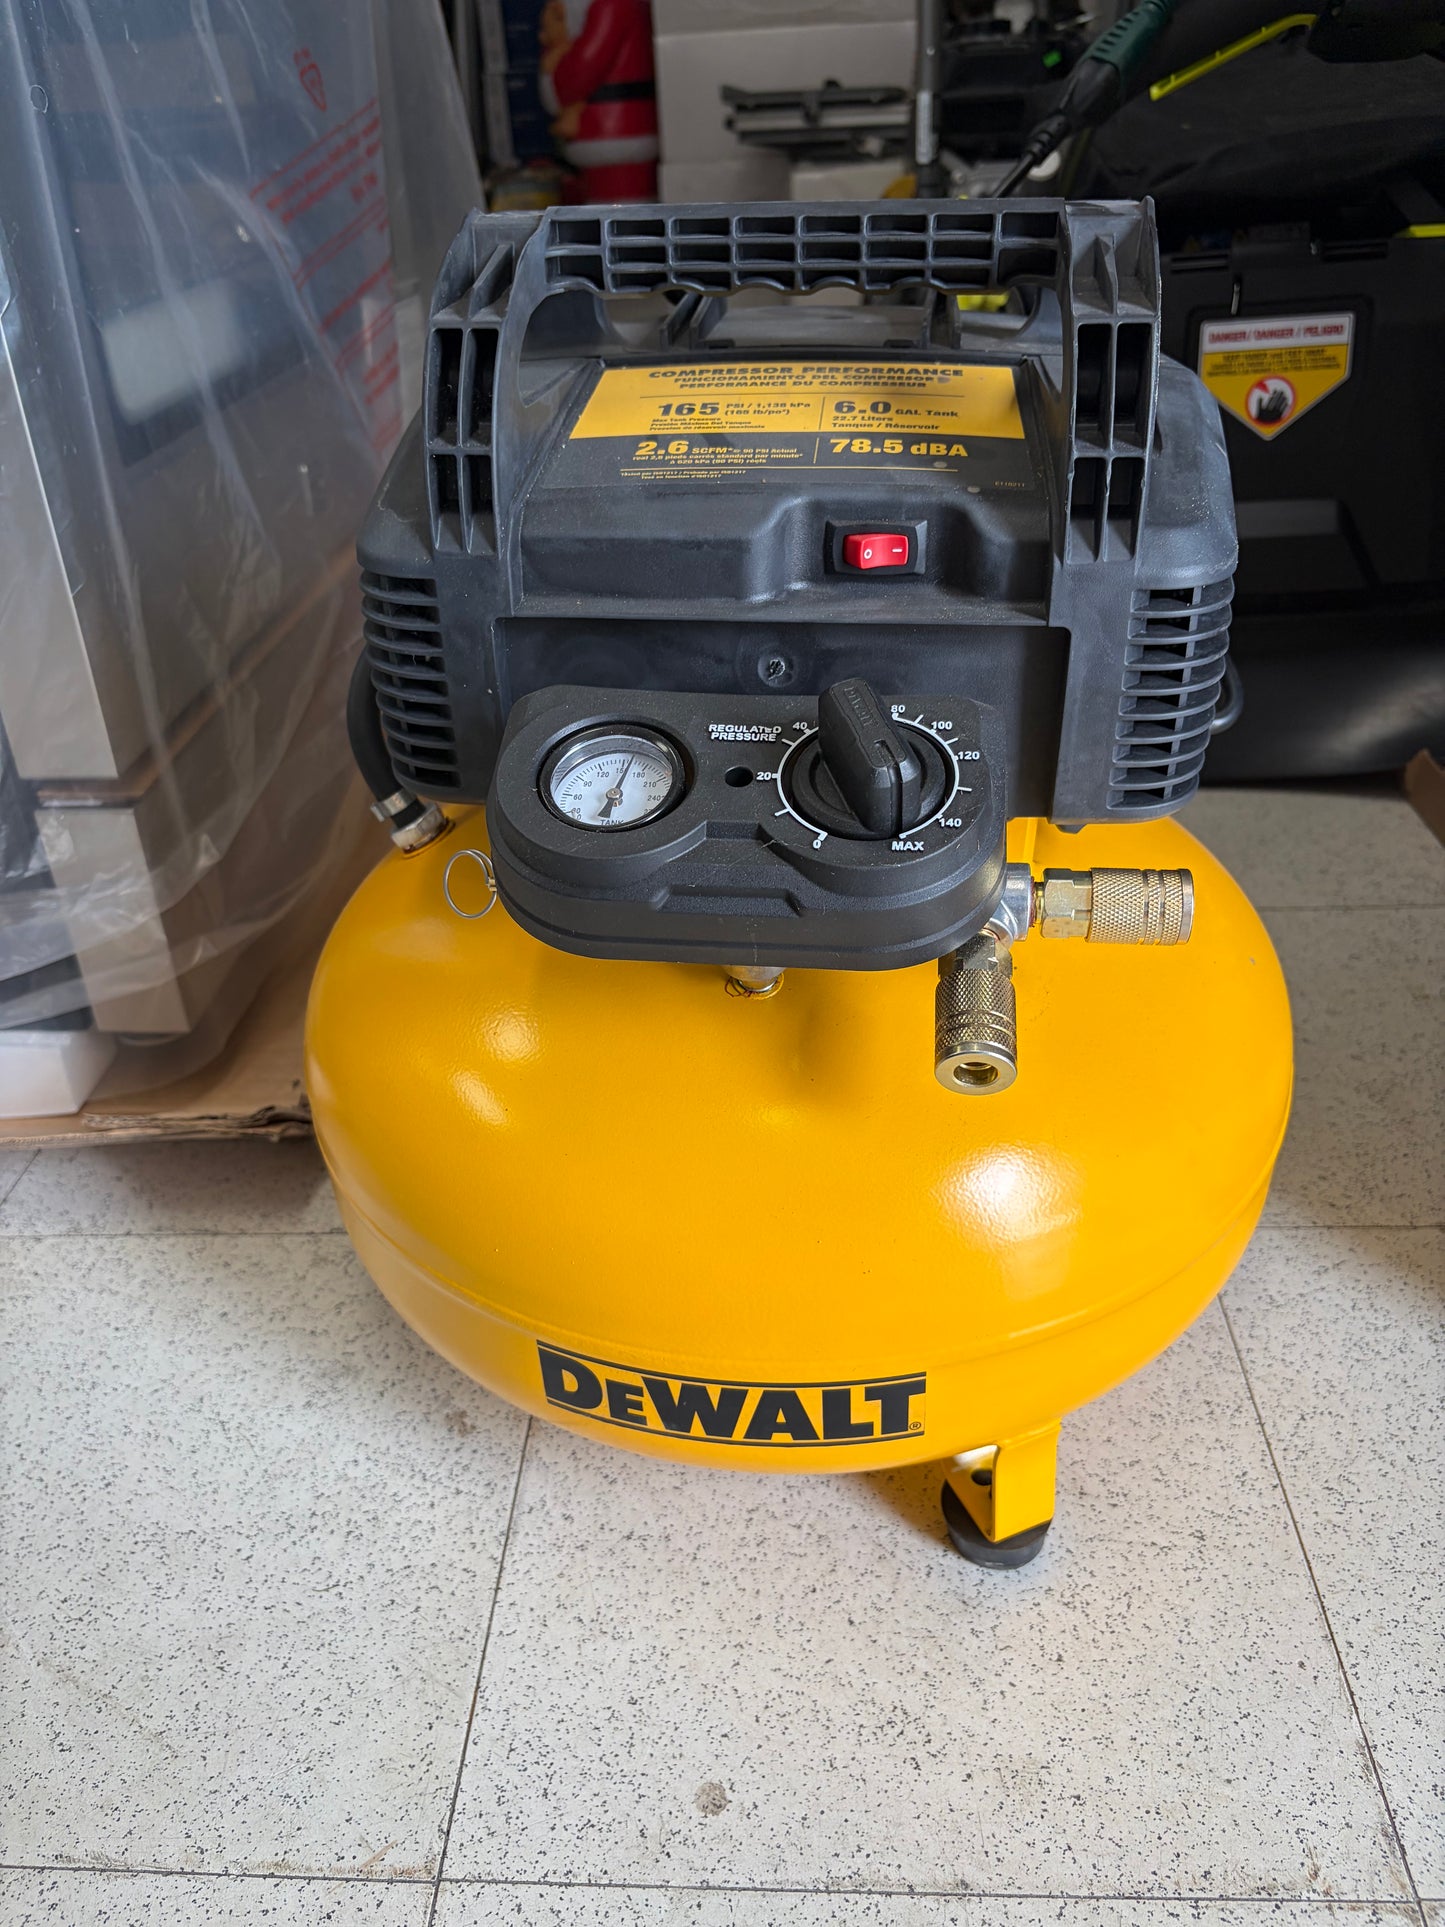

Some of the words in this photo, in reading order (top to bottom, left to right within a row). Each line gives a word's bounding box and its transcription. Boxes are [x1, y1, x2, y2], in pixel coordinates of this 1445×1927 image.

[649, 368, 792, 378] COMPRESSOR
[802, 367, 963, 376] PERFORMANCE
[674, 375, 806, 383] FUNCIONAMIENTO
[658, 402, 720, 416] 165
[834, 400, 892, 414] 6.0
[635, 440, 689, 456] 2.6
[830, 438, 904, 454] 78.5
[910, 442, 968, 456] dBA
[891, 704, 906, 713] 80
[708, 724, 782, 734] REGULATED
[792, 722, 808, 730] 40
[931, 721, 952, 730] 100
[711, 732, 777, 742] PRESSURE
[958, 751, 980, 760] 120
[756, 772, 772, 780] 20
[939, 818, 962, 828] 140
[812, 840, 822, 849] 0
[892, 841, 924, 851] MAX
